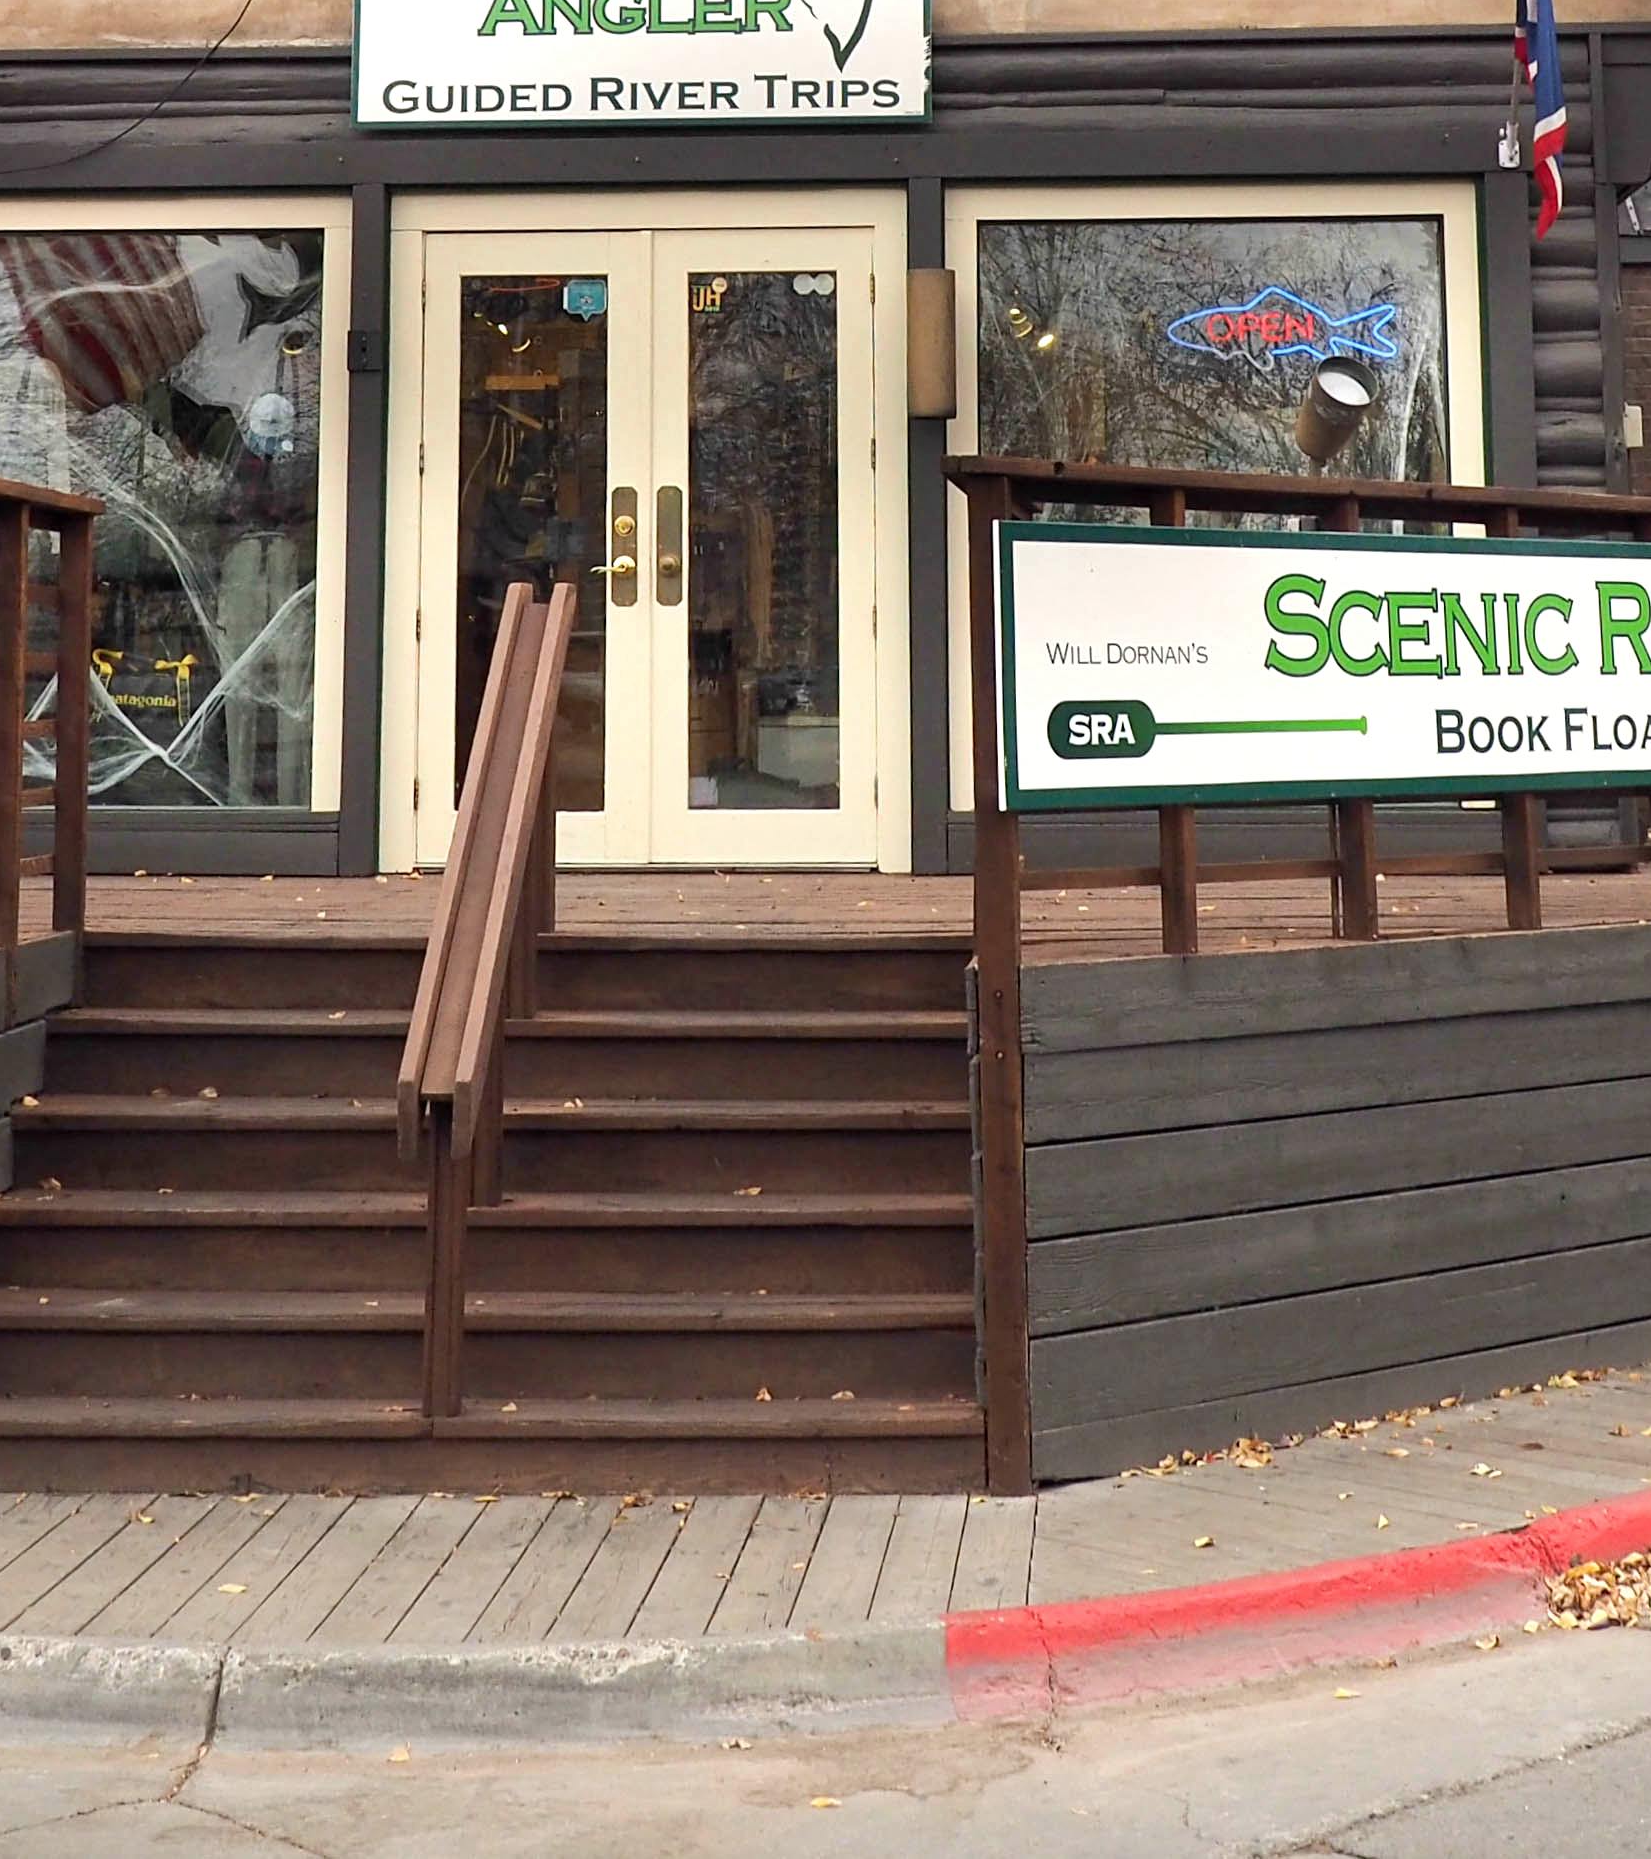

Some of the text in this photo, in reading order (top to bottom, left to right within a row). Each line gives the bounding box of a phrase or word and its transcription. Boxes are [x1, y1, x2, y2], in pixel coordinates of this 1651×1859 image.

[383, 74, 900, 114] GUIDED RIVER TRIPS
[1207, 312, 1315, 343] OPEN
[1264, 573, 1579, 679] SCENIC
[1046, 641, 1208, 665] WILL DORNAN'S
[112, 694, 177, 708] atagonia
[1068, 714, 1136, 746] SRA
[1435, 708, 1551, 754] BOOK
